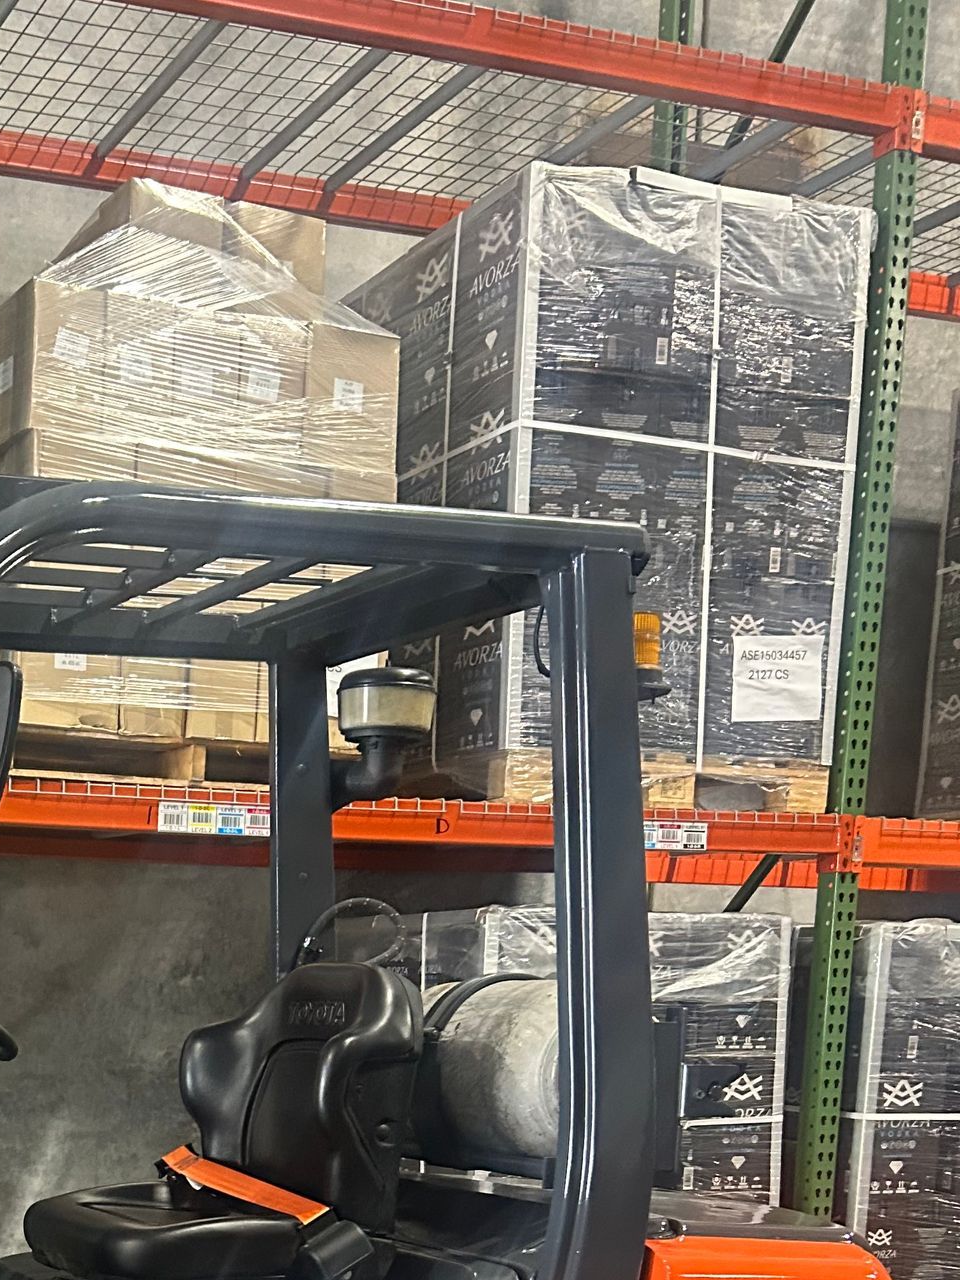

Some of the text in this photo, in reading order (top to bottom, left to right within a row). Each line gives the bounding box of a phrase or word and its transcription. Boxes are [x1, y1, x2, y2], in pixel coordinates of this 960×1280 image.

[740, 650, 808, 661] ASE15034457
[748, 670, 789, 680] 2127 CS
